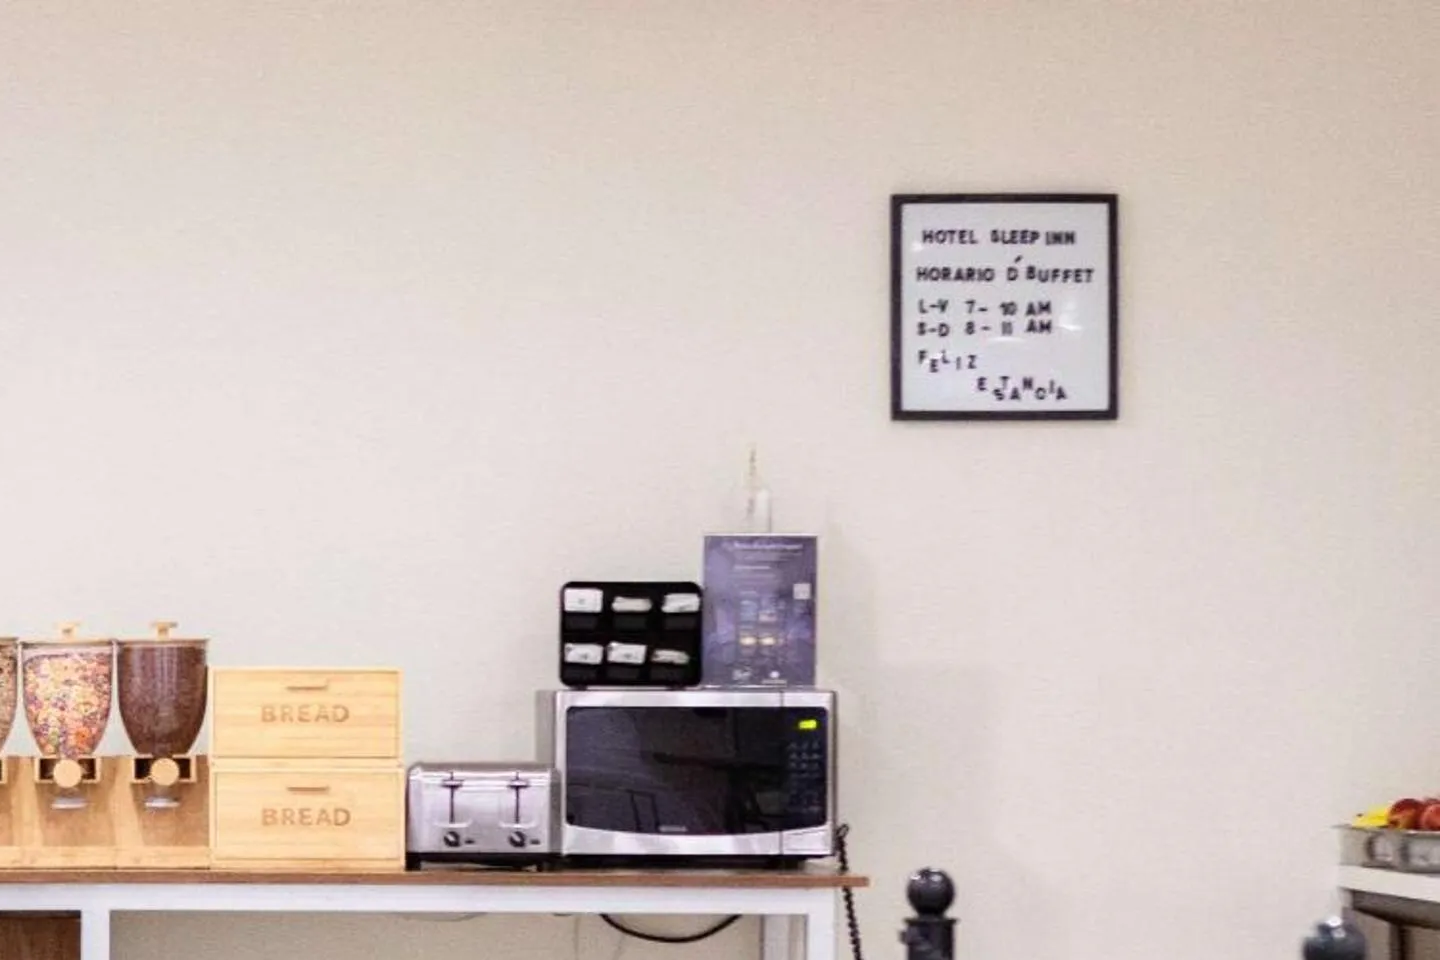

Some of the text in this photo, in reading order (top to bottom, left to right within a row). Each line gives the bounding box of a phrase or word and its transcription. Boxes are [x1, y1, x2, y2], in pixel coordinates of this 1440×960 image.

[922, 229, 1076, 245] HOTEL SLEEP INN
[916, 266, 995, 281] HORARIO
[1026, 265, 1095, 283] BUFFET
[918, 299, 949, 314] L-V
[1000, 301, 1017, 316] 10
[1025, 301, 1052, 316] AM
[917, 321, 950, 337] S-D
[1025, 319, 1053, 334] AM
[917, 350, 977, 373] FELIZ
[977, 376, 1068, 401] ESTANCIA
[261, 704, 350, 723] BREAD
[261, 807, 352, 826] BREAD
